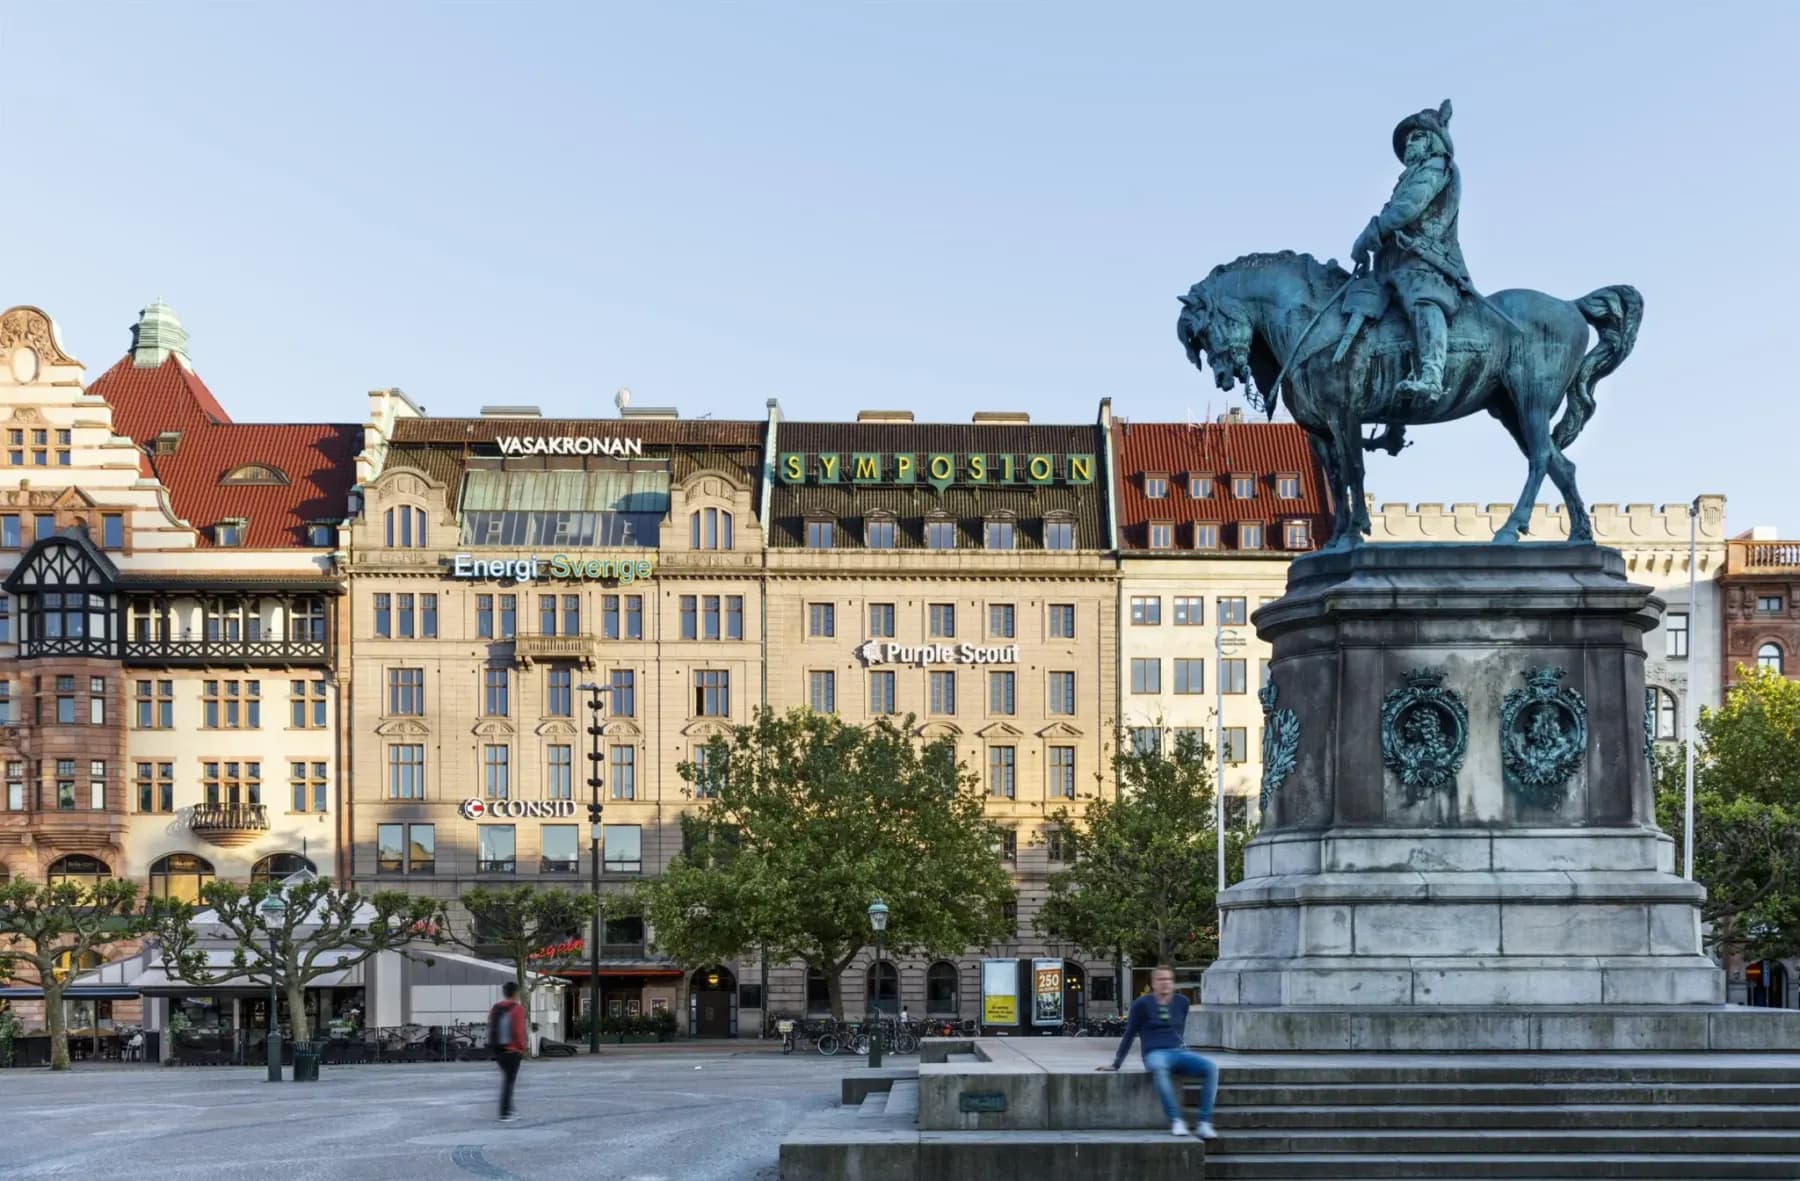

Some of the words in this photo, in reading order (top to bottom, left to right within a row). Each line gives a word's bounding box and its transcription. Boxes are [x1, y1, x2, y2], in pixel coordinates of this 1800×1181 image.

[497, 436, 642, 456] VASAKRONAN
[788, 456, 1091, 481] SYMPOSION
[455, 554, 537, 581] Energi
[551, 554, 651, 583] Sverige
[887, 642, 954, 667] Purple
[960, 642, 1020, 664] Scout
[493, 800, 577, 818] CONSID
[1039, 974, 1059, 987] 250
